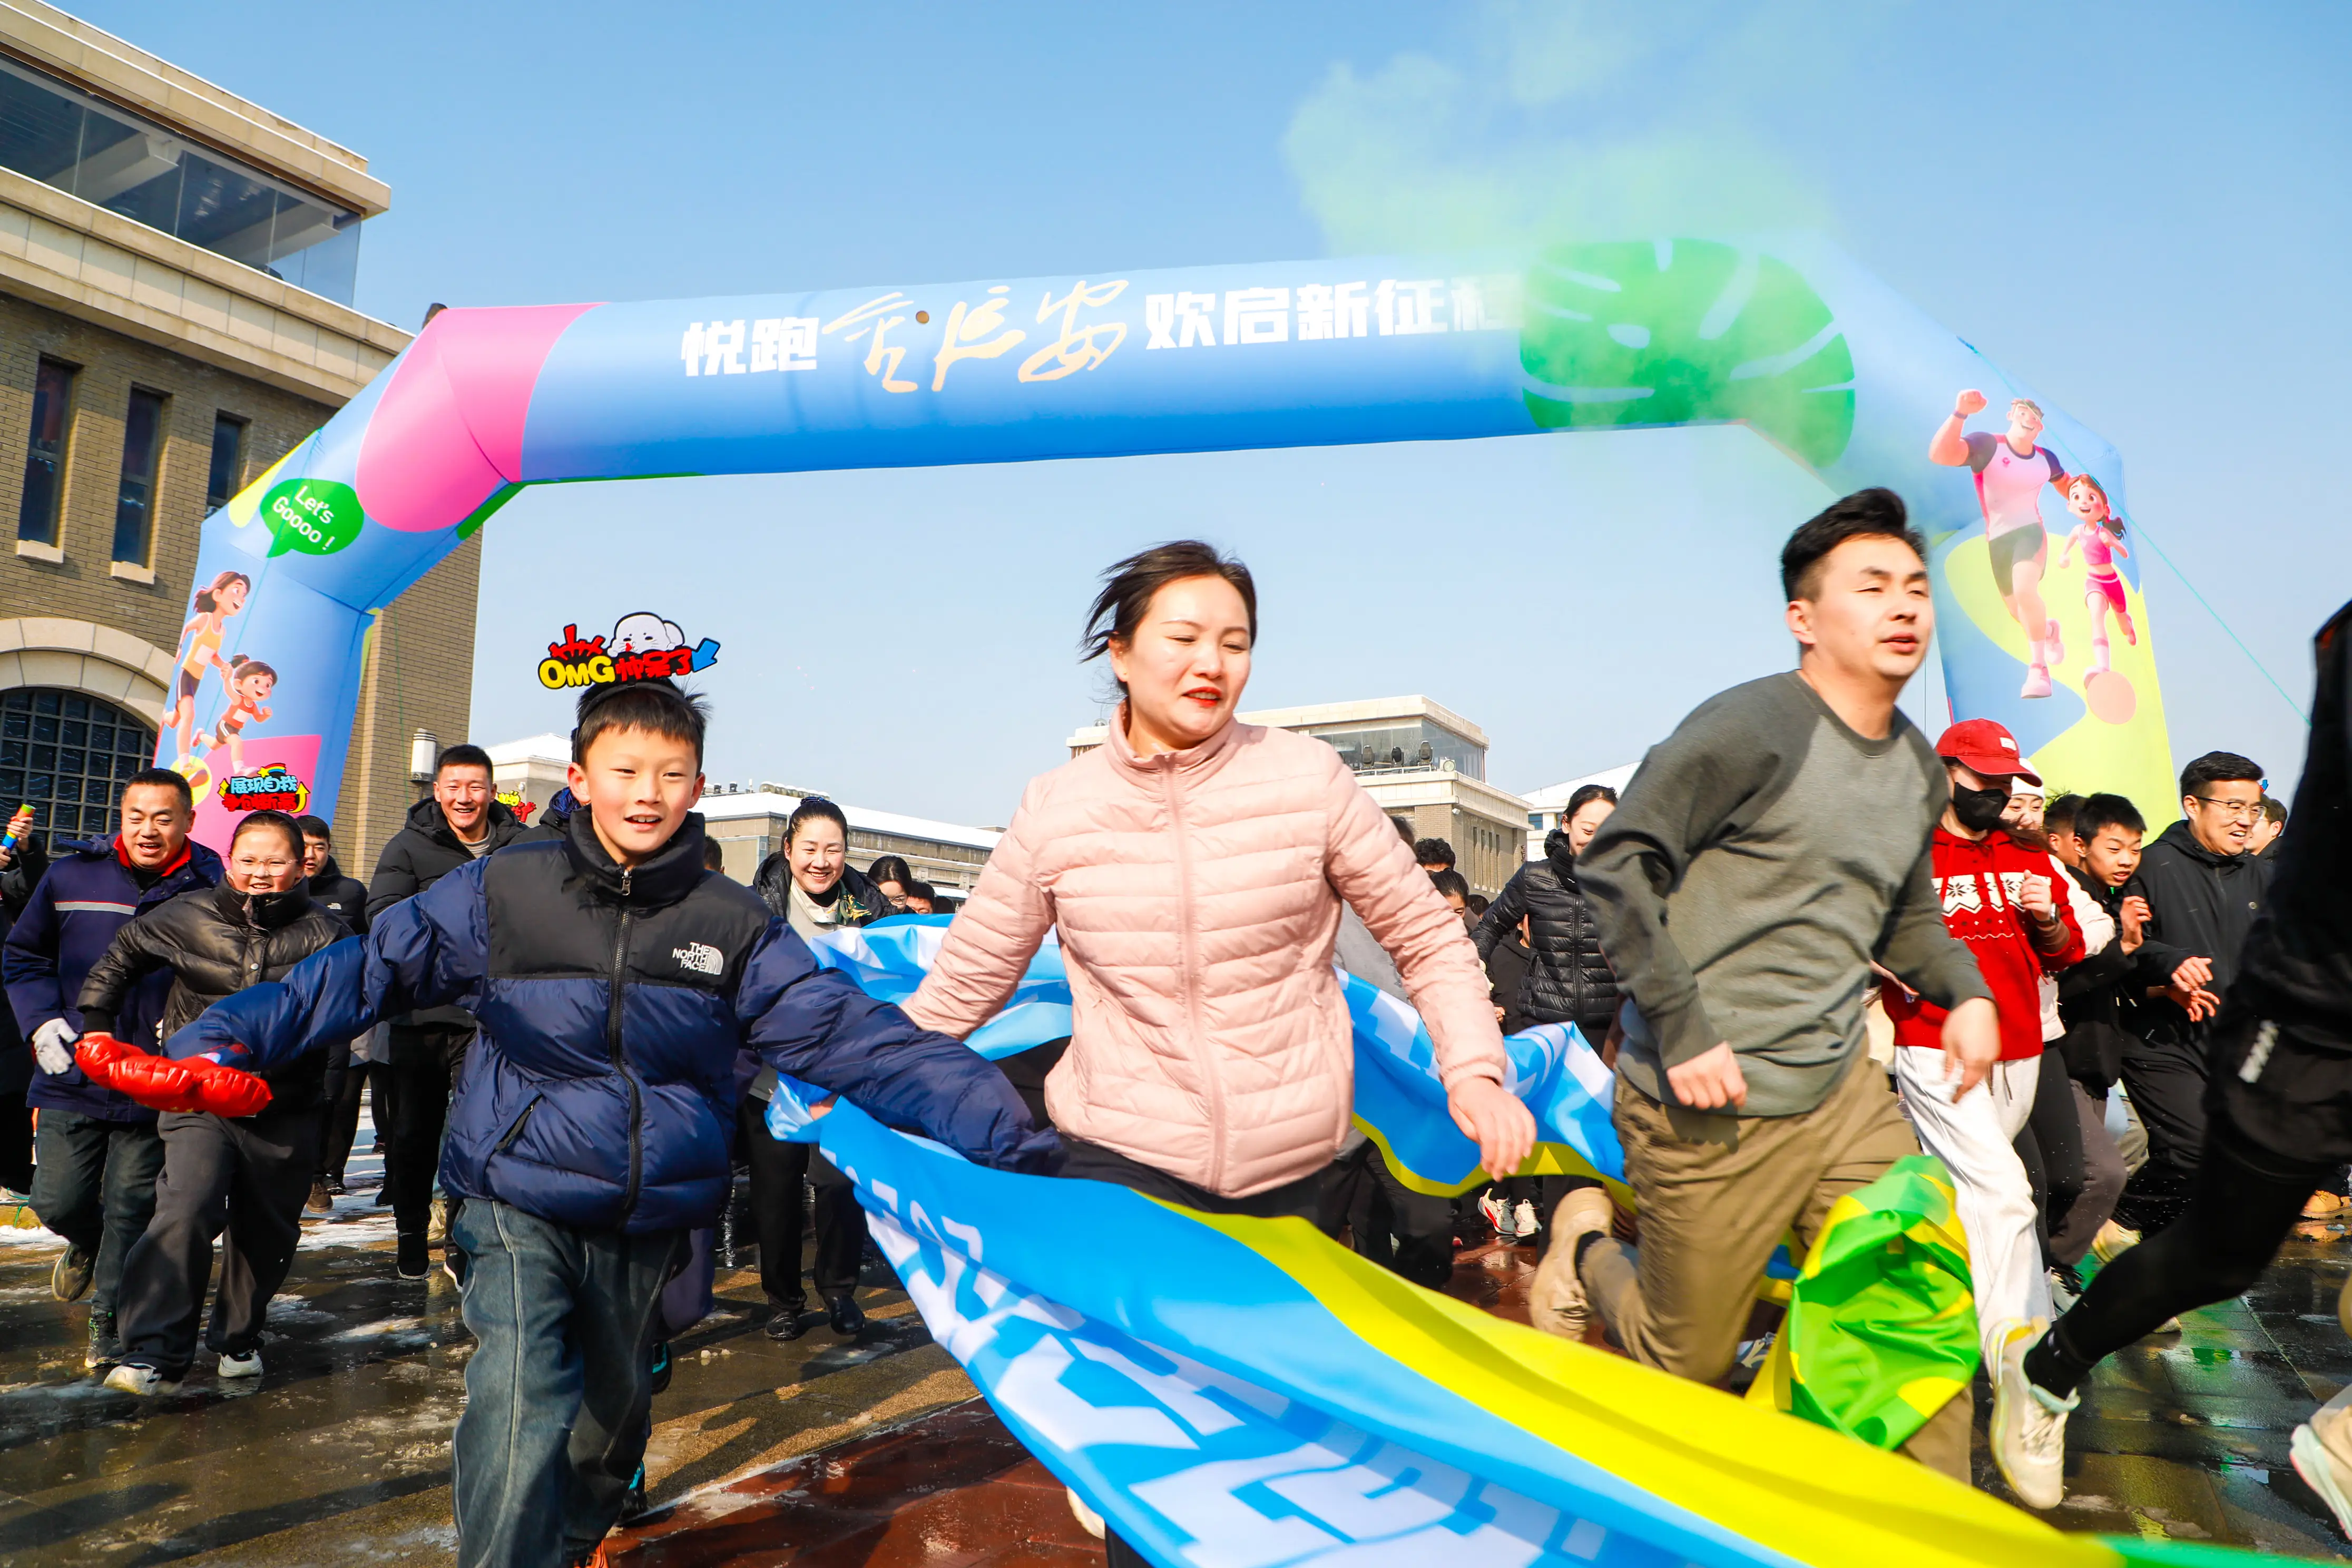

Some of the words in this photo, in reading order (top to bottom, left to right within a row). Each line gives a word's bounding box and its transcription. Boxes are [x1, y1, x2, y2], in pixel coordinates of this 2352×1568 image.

[681, 316, 819, 377] 悦跑
[295, 485, 335, 524] Let's
[539, 655, 616, 688] OMG
[615, 648, 692, 681] 帅呆了
[231, 775, 298, 794] 展现自我
[672, 948, 708, 964] NORTH
[690, 942, 711, 955] THE
[680, 959, 707, 972] FACE
